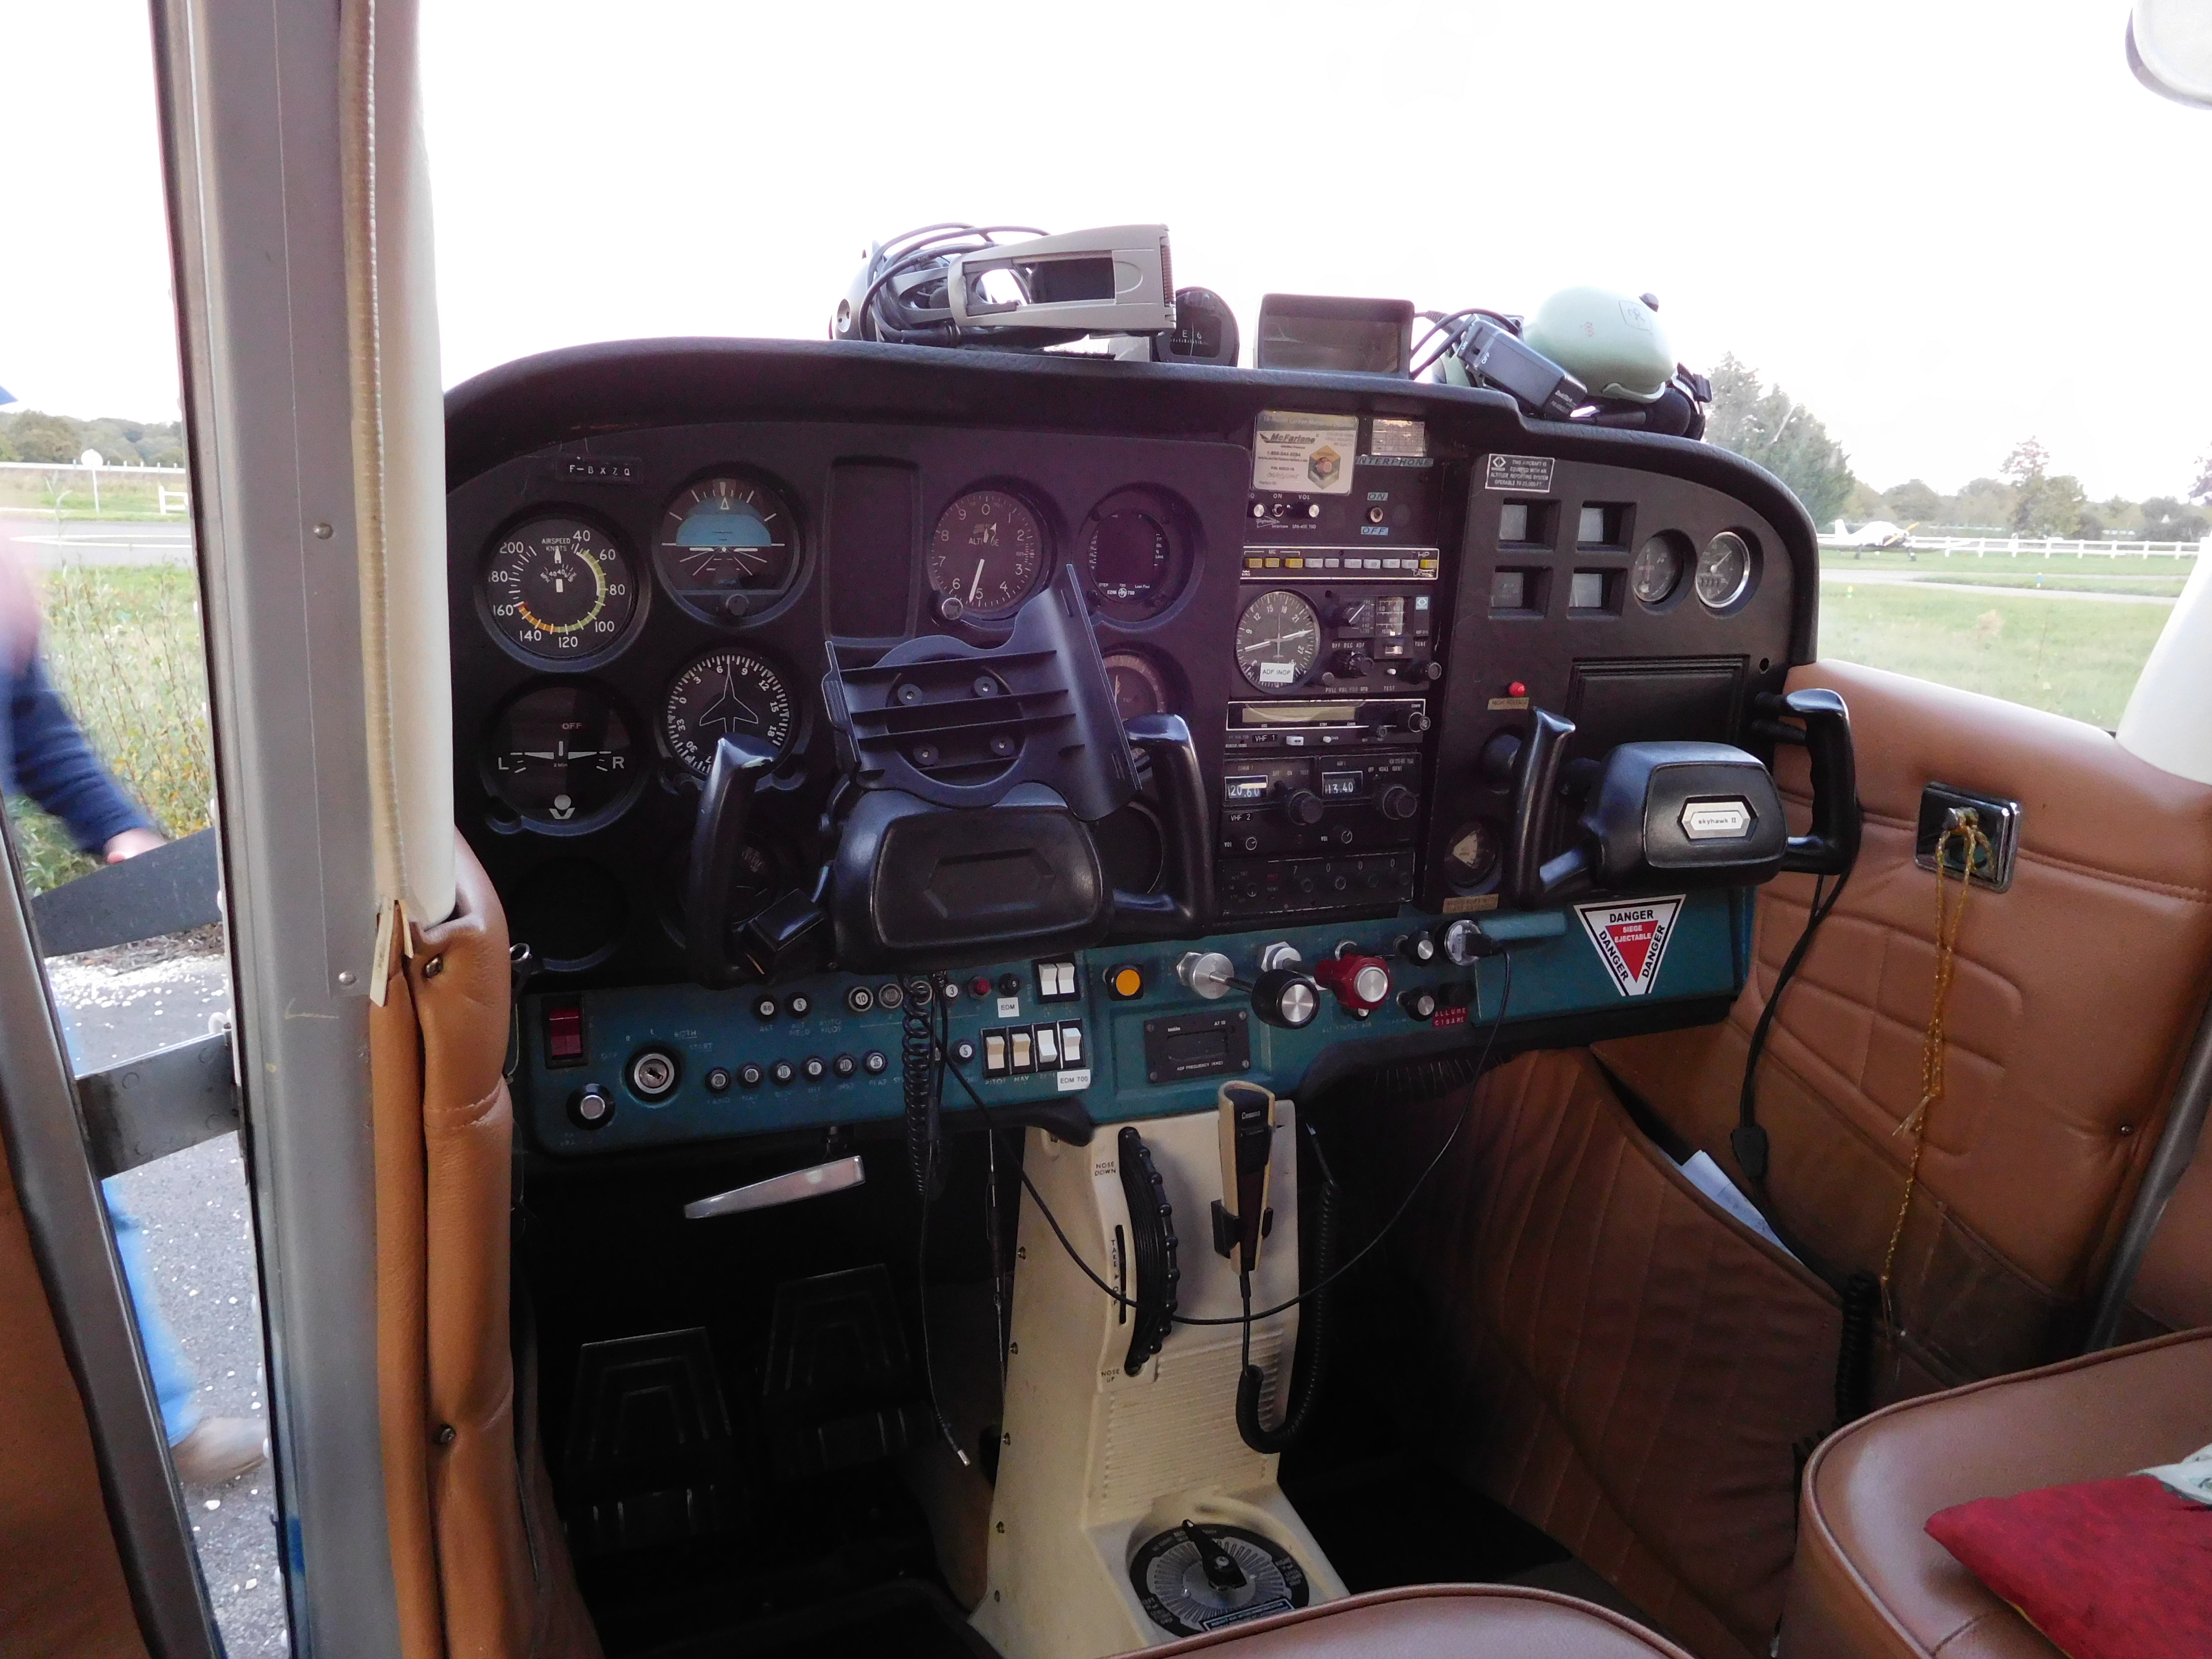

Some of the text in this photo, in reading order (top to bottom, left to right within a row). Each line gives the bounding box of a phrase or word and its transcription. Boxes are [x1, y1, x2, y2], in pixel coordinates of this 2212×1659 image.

[1196, 331, 1202, 339] 6
[958, 509, 966, 520] 9
[981, 504, 990, 515] 0
[572, 530, 591, 542] 40
[941, 530, 949, 541] 8
[1017, 529, 1025, 541] 2
[499, 542, 524, 554] 200
[599, 549, 616, 560] 60
[1015, 564, 1023, 575] 3
[952, 578, 961, 589] 6
[999, 580, 1008, 592] 4
[609, 584, 625, 596] 80
[975, 588, 984, 600] 5
[493, 604, 514, 616] 160
[1253, 613, 1261, 621] 12
[1291, 614, 1299, 623] 21
[594, 621, 615, 633] 100
[519, 630, 542, 642] 140
[558, 636, 578, 648] 120
[716, 665, 723, 673] 6
[741, 667, 748, 675] 9
[693, 676, 701, 684] 3
[758, 679, 769, 691] 12
[769, 701, 780, 713] 15
[562, 721, 583, 730] OFF
[676, 719, 686, 732] 33
[767, 725, 777, 737] 18
[1255, 734, 1267, 743] VHF
[685, 740, 698, 753] 30
[498, 757, 509, 770] L
[612, 756, 625, 769] R
[1609, 909, 1654, 923] DANGER
[1623, 925, 1643, 933] SIEGE
[1614, 933, 1652, 943] EJECTABLE
[1599, 930, 1629, 982] DANGER
[1641, 925, 1666, 978] DANGER
[963, 1046, 969, 1055] 5
[1094, 1168, 1116, 1177] DOWN
[1101, 1369, 1119, 1377] NOSE
